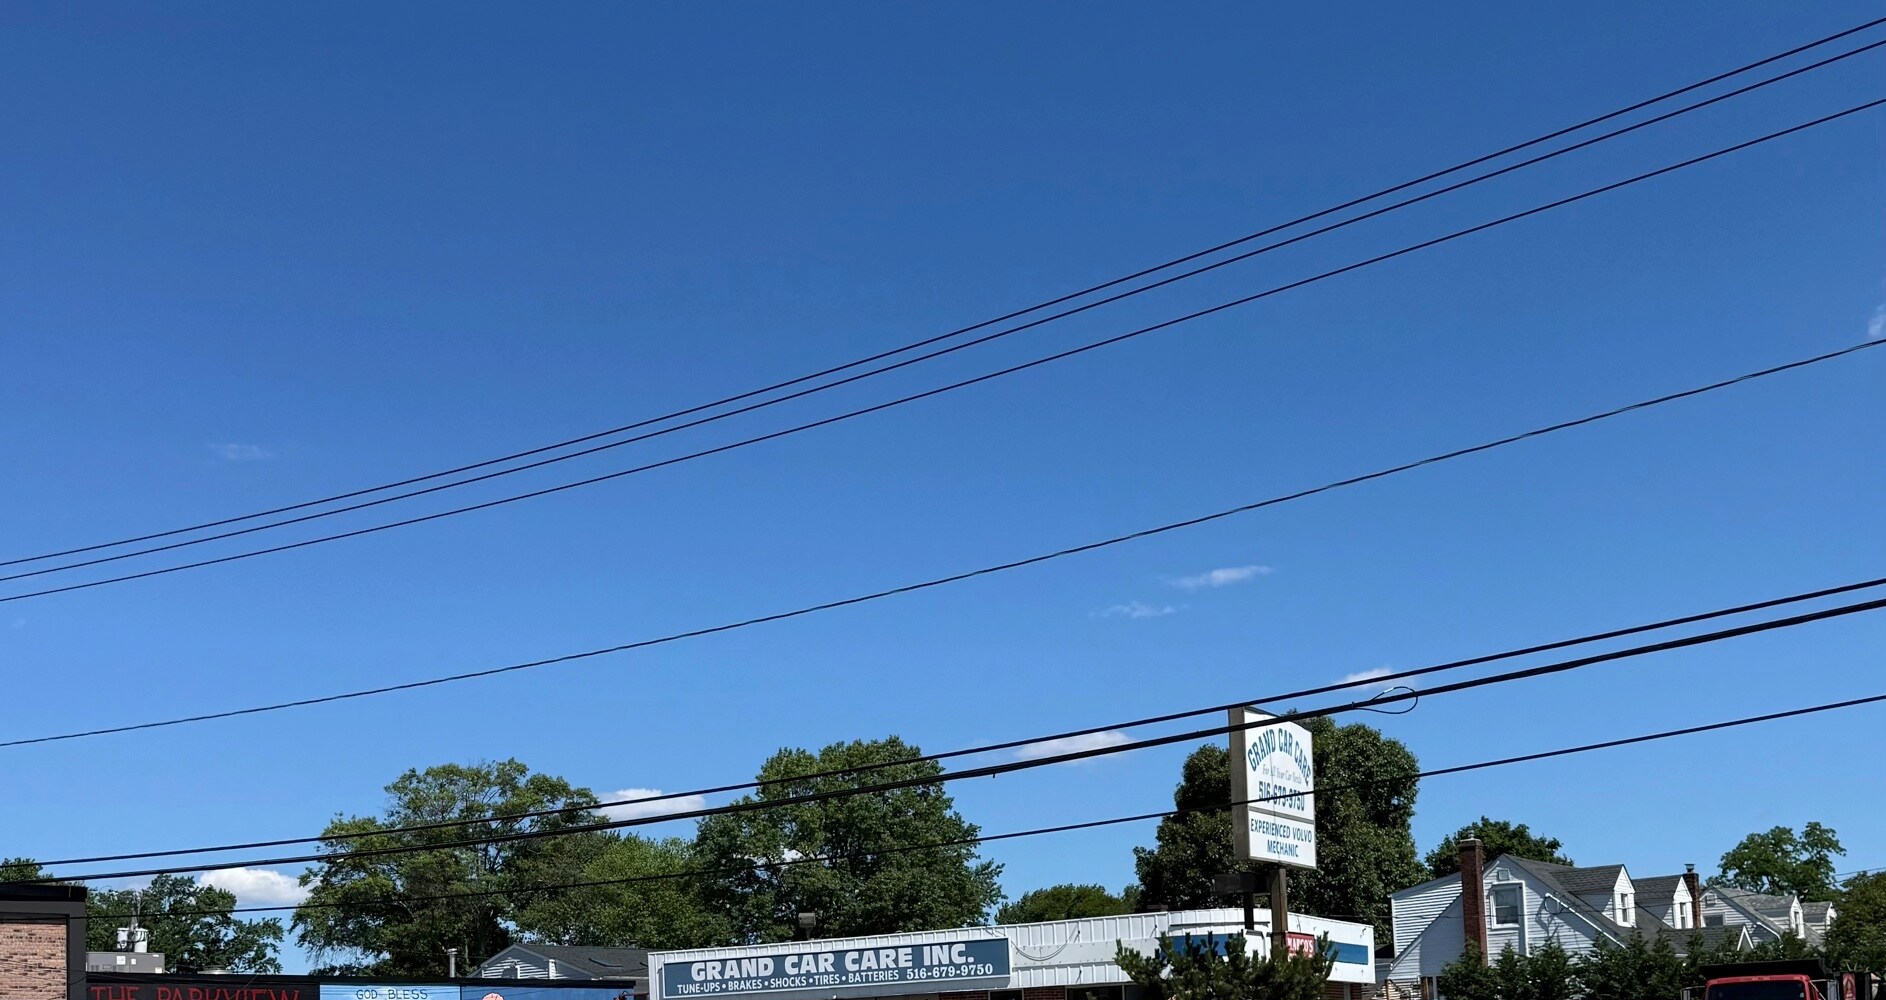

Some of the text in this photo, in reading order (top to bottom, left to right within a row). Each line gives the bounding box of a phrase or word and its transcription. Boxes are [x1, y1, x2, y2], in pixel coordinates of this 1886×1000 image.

[1247, 727, 1311, 786] GRAND CAR CARE
[1250, 818, 1312, 843] EXPERIENCED VOLVO
[1266, 839, 1299, 858] MECHANIC
[691, 943, 975, 982] GRAND CAR CARE INC.
[677, 963, 994, 994] TUNE-UPS BRAKES SHOCKS TIRES BATTERIES 516-679-9750
[356, 988, 428, 1000] GOD BLESS
